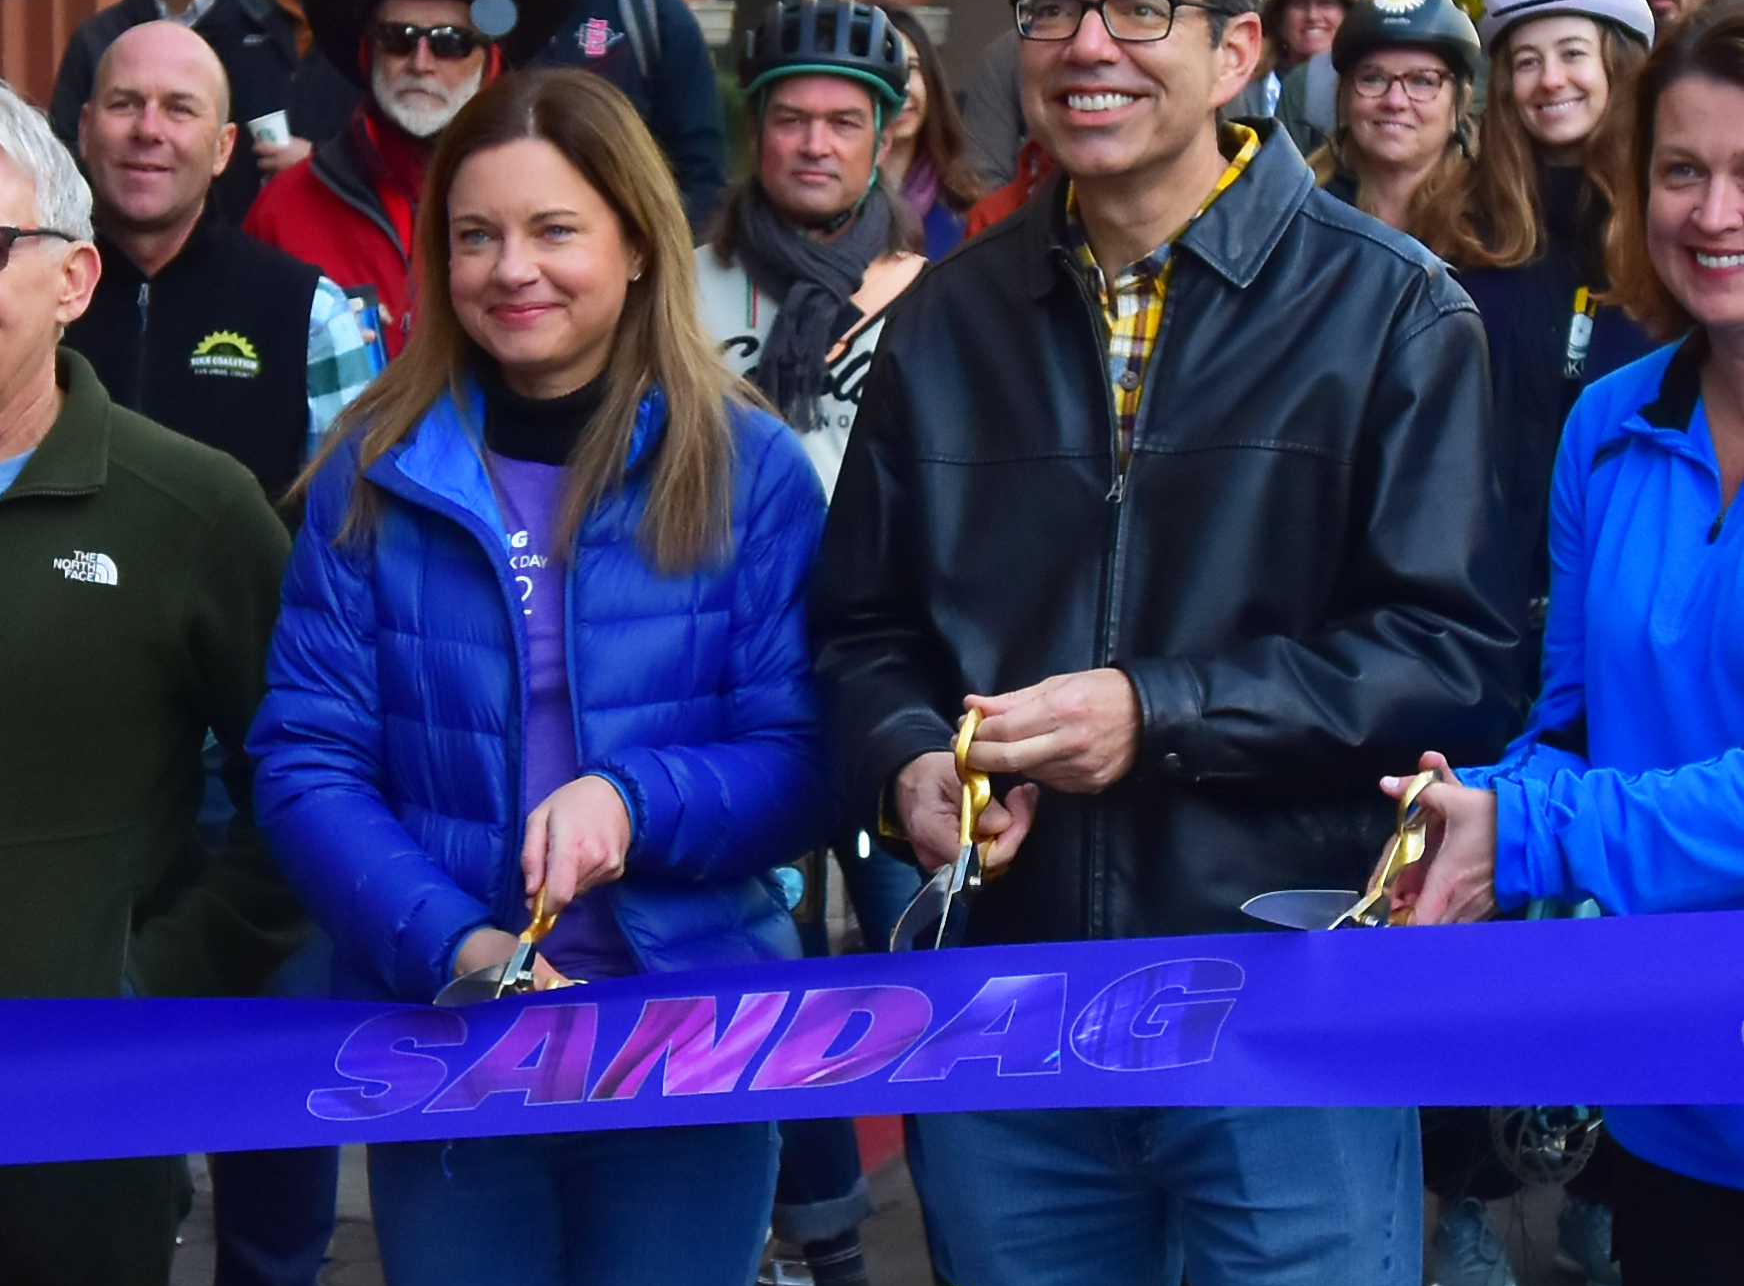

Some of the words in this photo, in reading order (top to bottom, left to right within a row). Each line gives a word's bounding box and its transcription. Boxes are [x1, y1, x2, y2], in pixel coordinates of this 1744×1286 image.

[73, 549, 97, 563] THE
[519, 554, 548, 568] DAY
[53, 557, 96, 573] NORTH
[64, 568, 96, 582] FACE
[305, 957, 1246, 1121] SANDAG
